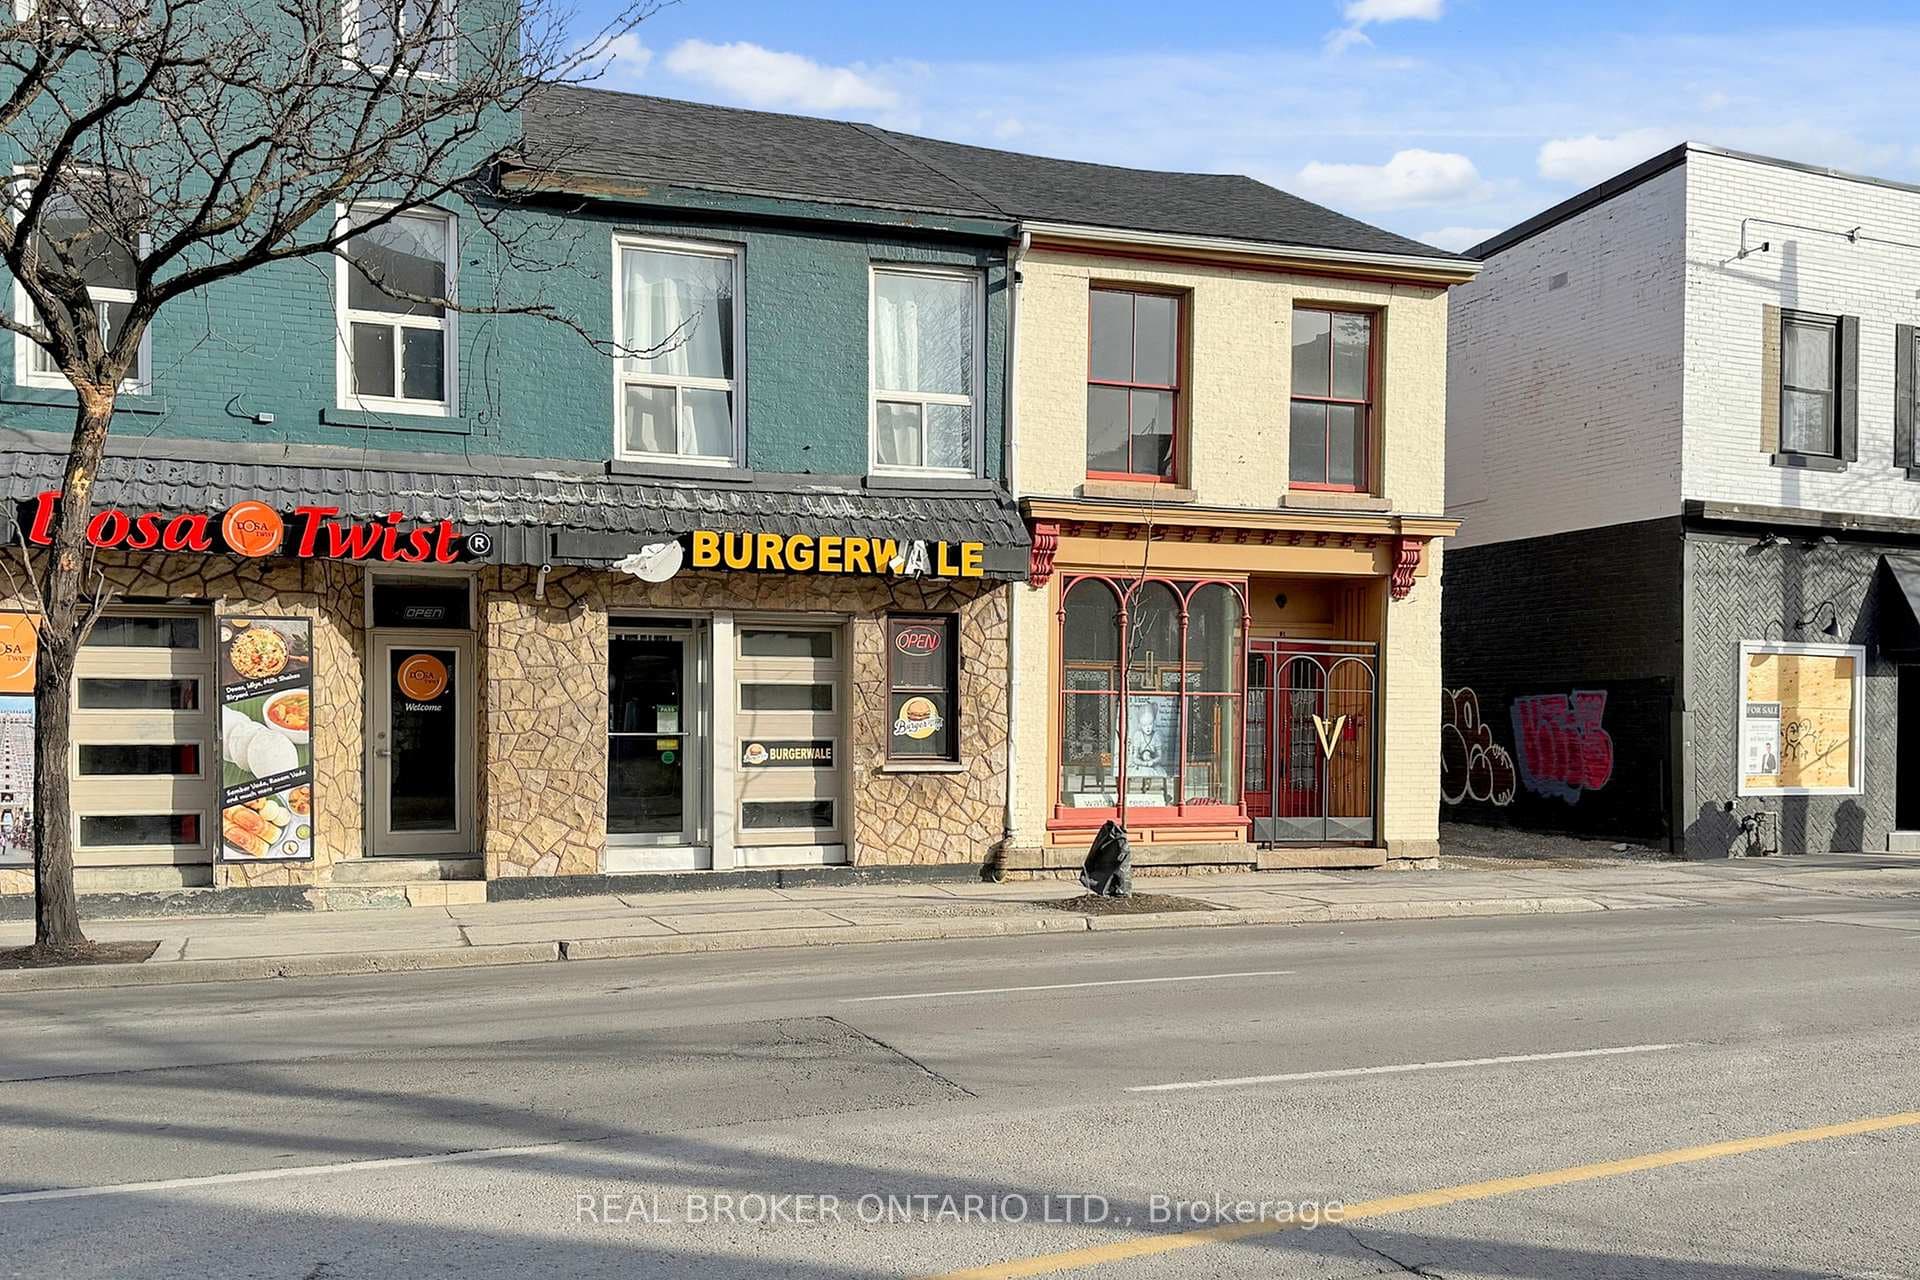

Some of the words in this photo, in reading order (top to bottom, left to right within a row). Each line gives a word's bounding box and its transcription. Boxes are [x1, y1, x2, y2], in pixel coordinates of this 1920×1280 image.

[236, 519, 269, 532] DOSA
[295, 506, 462, 563] Twist
[692, 530, 984, 577] BURGERWALE
[406, 608, 442, 618] OPEN
[898, 633, 937, 649] OPEN
[0, 642, 22, 655] SA
[405, 703, 442, 711] Welcome
[1747, 706, 1762, 714] FOR
[1762, 706, 1778, 714] SALE
[769, 747, 831, 760] BURGERWALE
